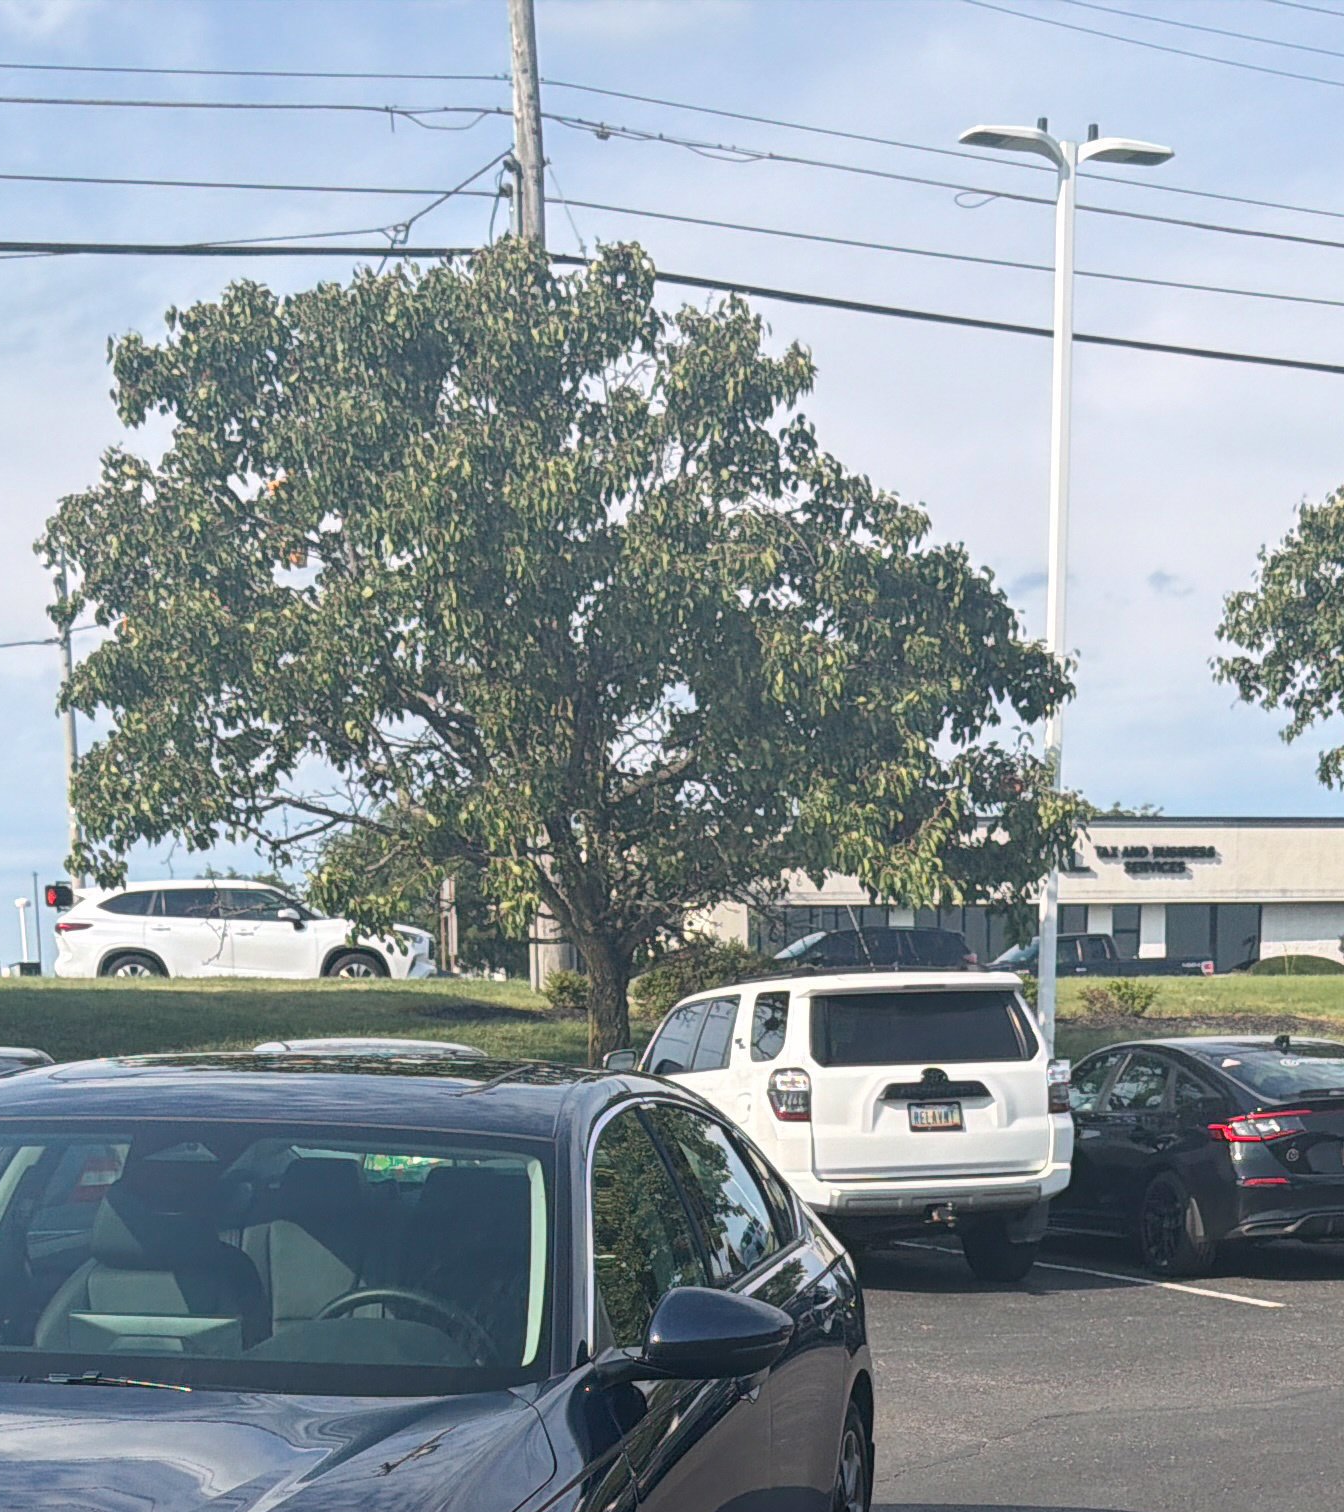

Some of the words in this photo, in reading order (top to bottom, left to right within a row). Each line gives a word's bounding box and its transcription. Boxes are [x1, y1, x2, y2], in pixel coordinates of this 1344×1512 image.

[1093, 845, 1119, 858] TAX
[1122, 845, 1149, 858] AND
[1152, 845, 1216, 859] BUSINESS
[1124, 861, 1186, 874] SERVICES
